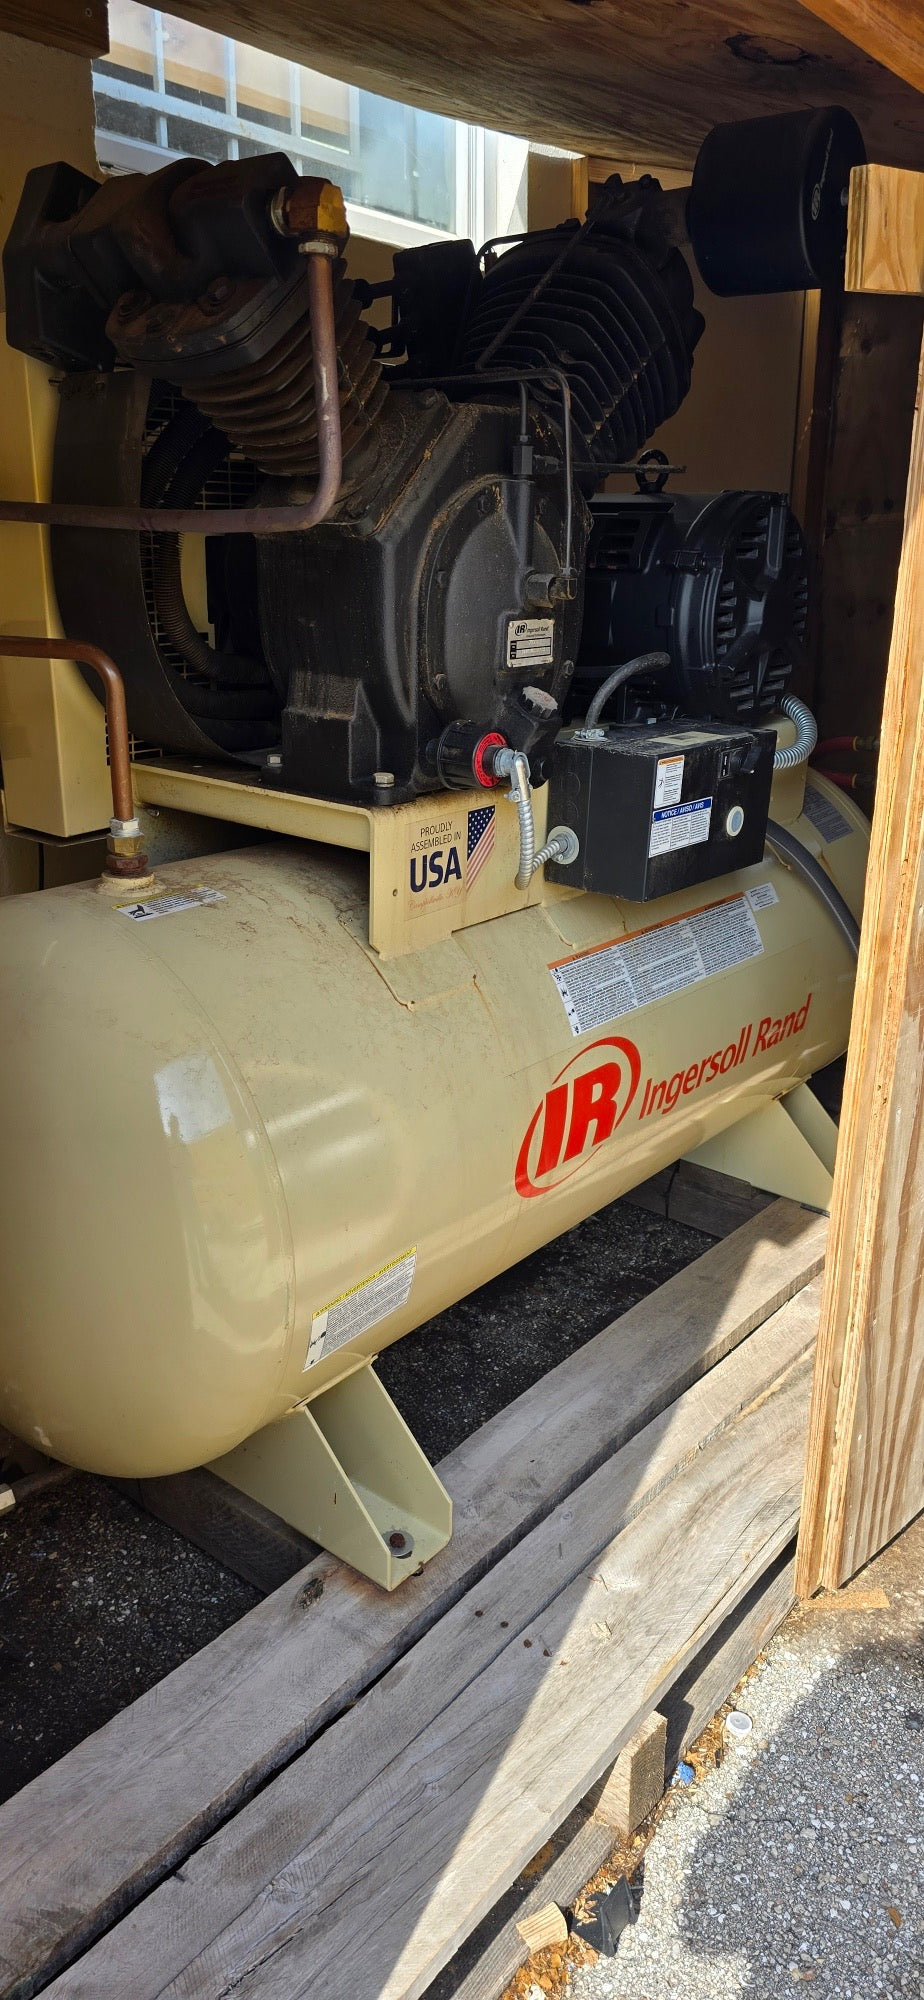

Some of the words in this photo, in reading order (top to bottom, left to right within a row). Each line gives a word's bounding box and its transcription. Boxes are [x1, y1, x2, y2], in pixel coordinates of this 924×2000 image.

[420, 821, 453, 837] PROUDLY
[661, 808, 677, 819] NOTICE
[411, 833, 453, 853] ASSEMBLED
[454, 831, 462, 841] IN
[410, 846, 462, 893] USA
[638, 1023, 752, 1121] Ingersoll
[752, 993, 813, 1058] Rand
[534, 1061, 622, 1180] IR
